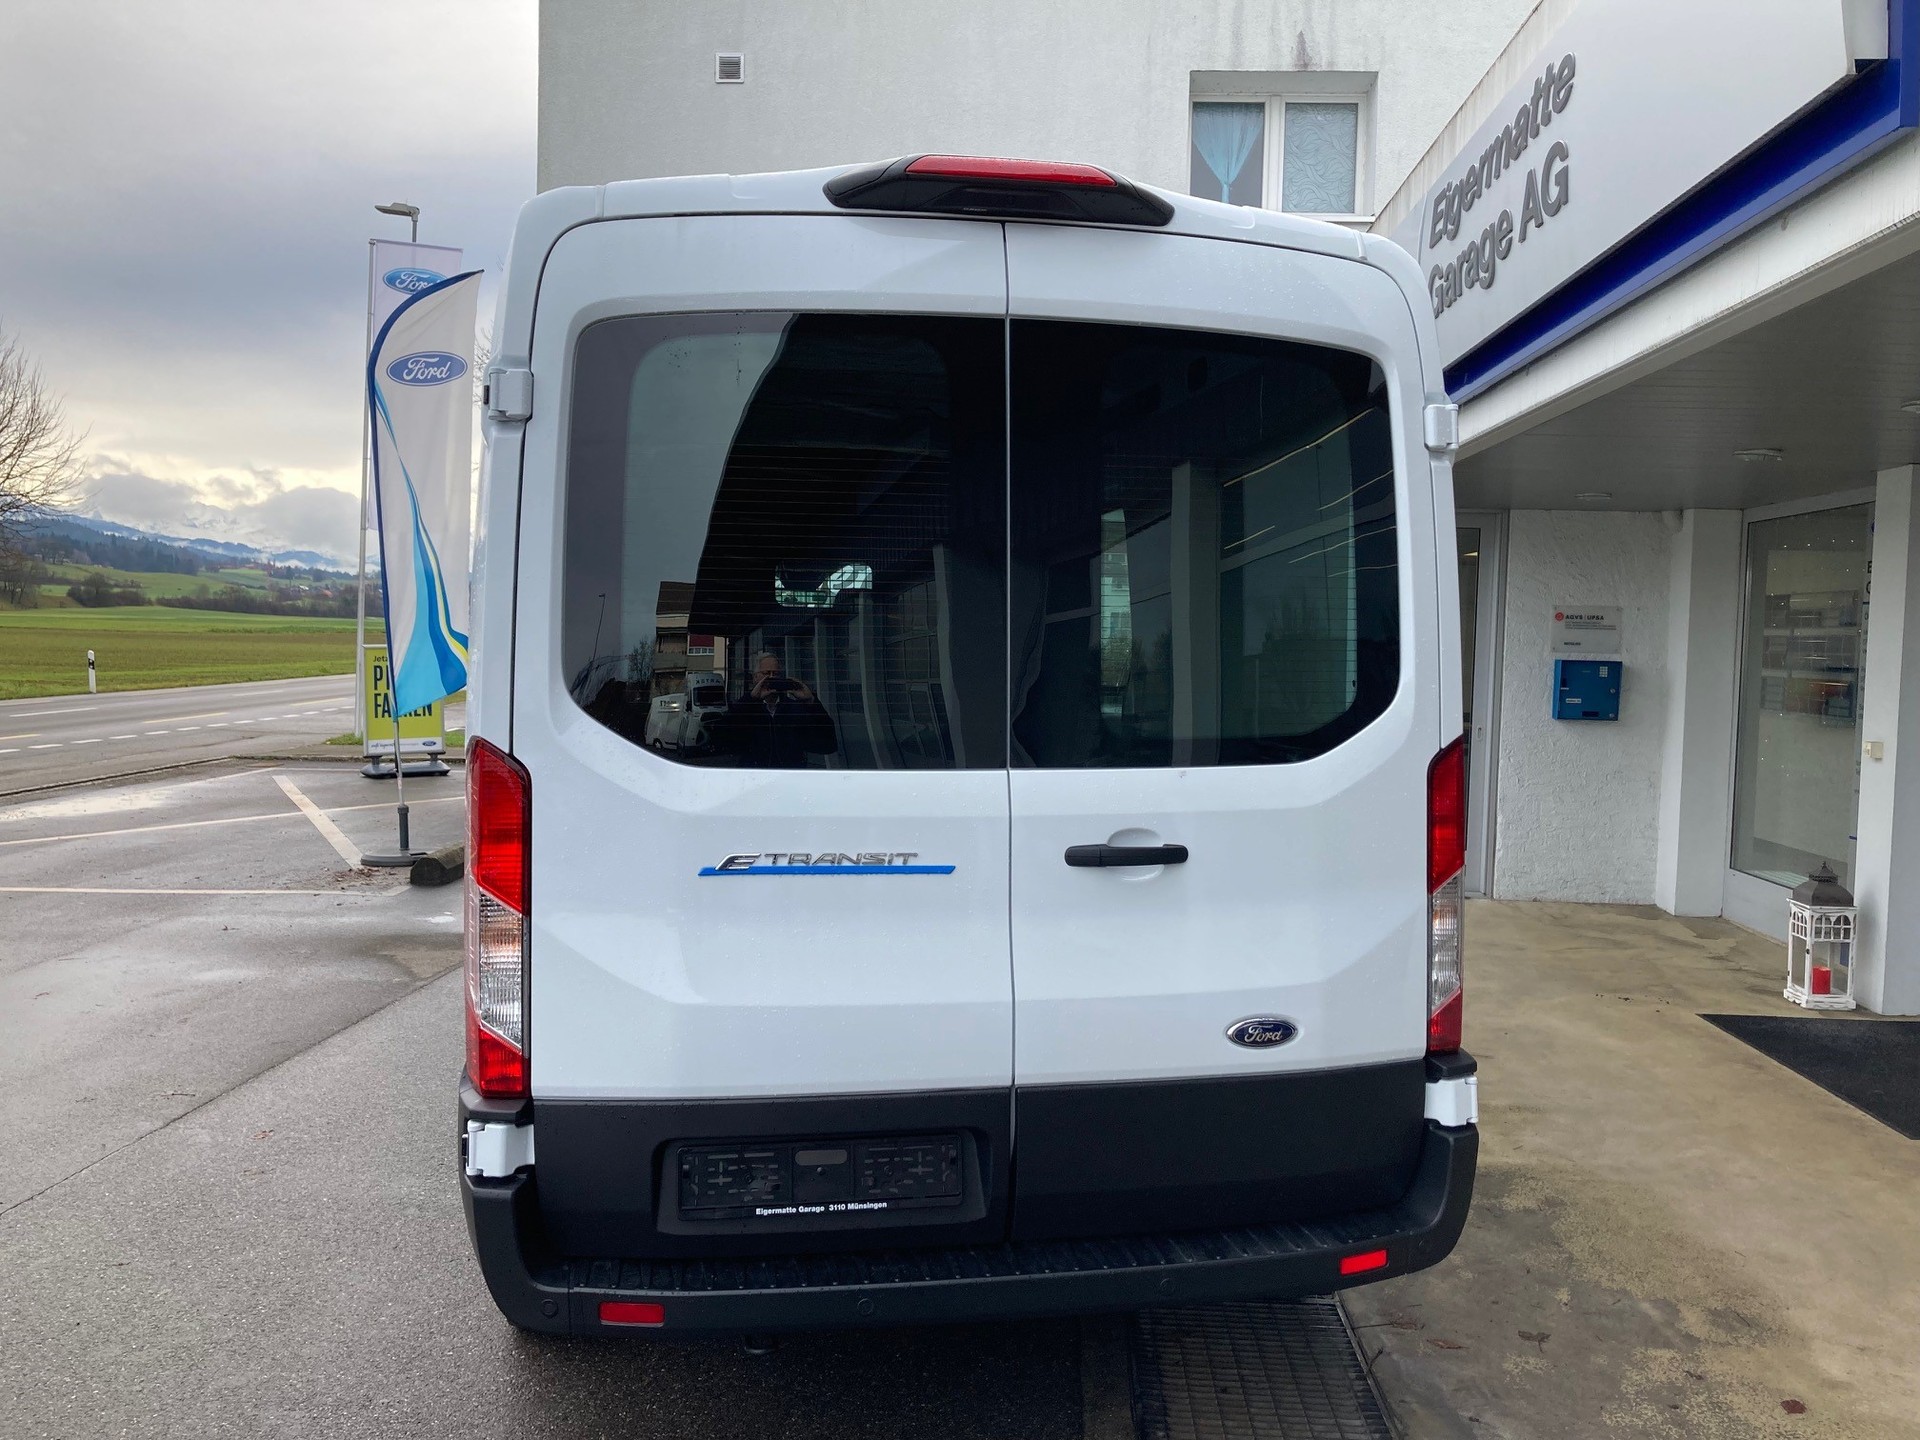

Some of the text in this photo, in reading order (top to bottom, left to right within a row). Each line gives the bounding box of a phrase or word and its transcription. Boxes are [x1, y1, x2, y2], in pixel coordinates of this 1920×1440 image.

[1429, 52, 1576, 249] Eigermatte
[1428, 140, 1569, 319] Garage AG
[403, 357, 451, 380] Ford
[1244, 1024, 1283, 1043] Ford
[798, 1205, 826, 1214] Garage
[847, 1201, 888, 1210] Münsingen
